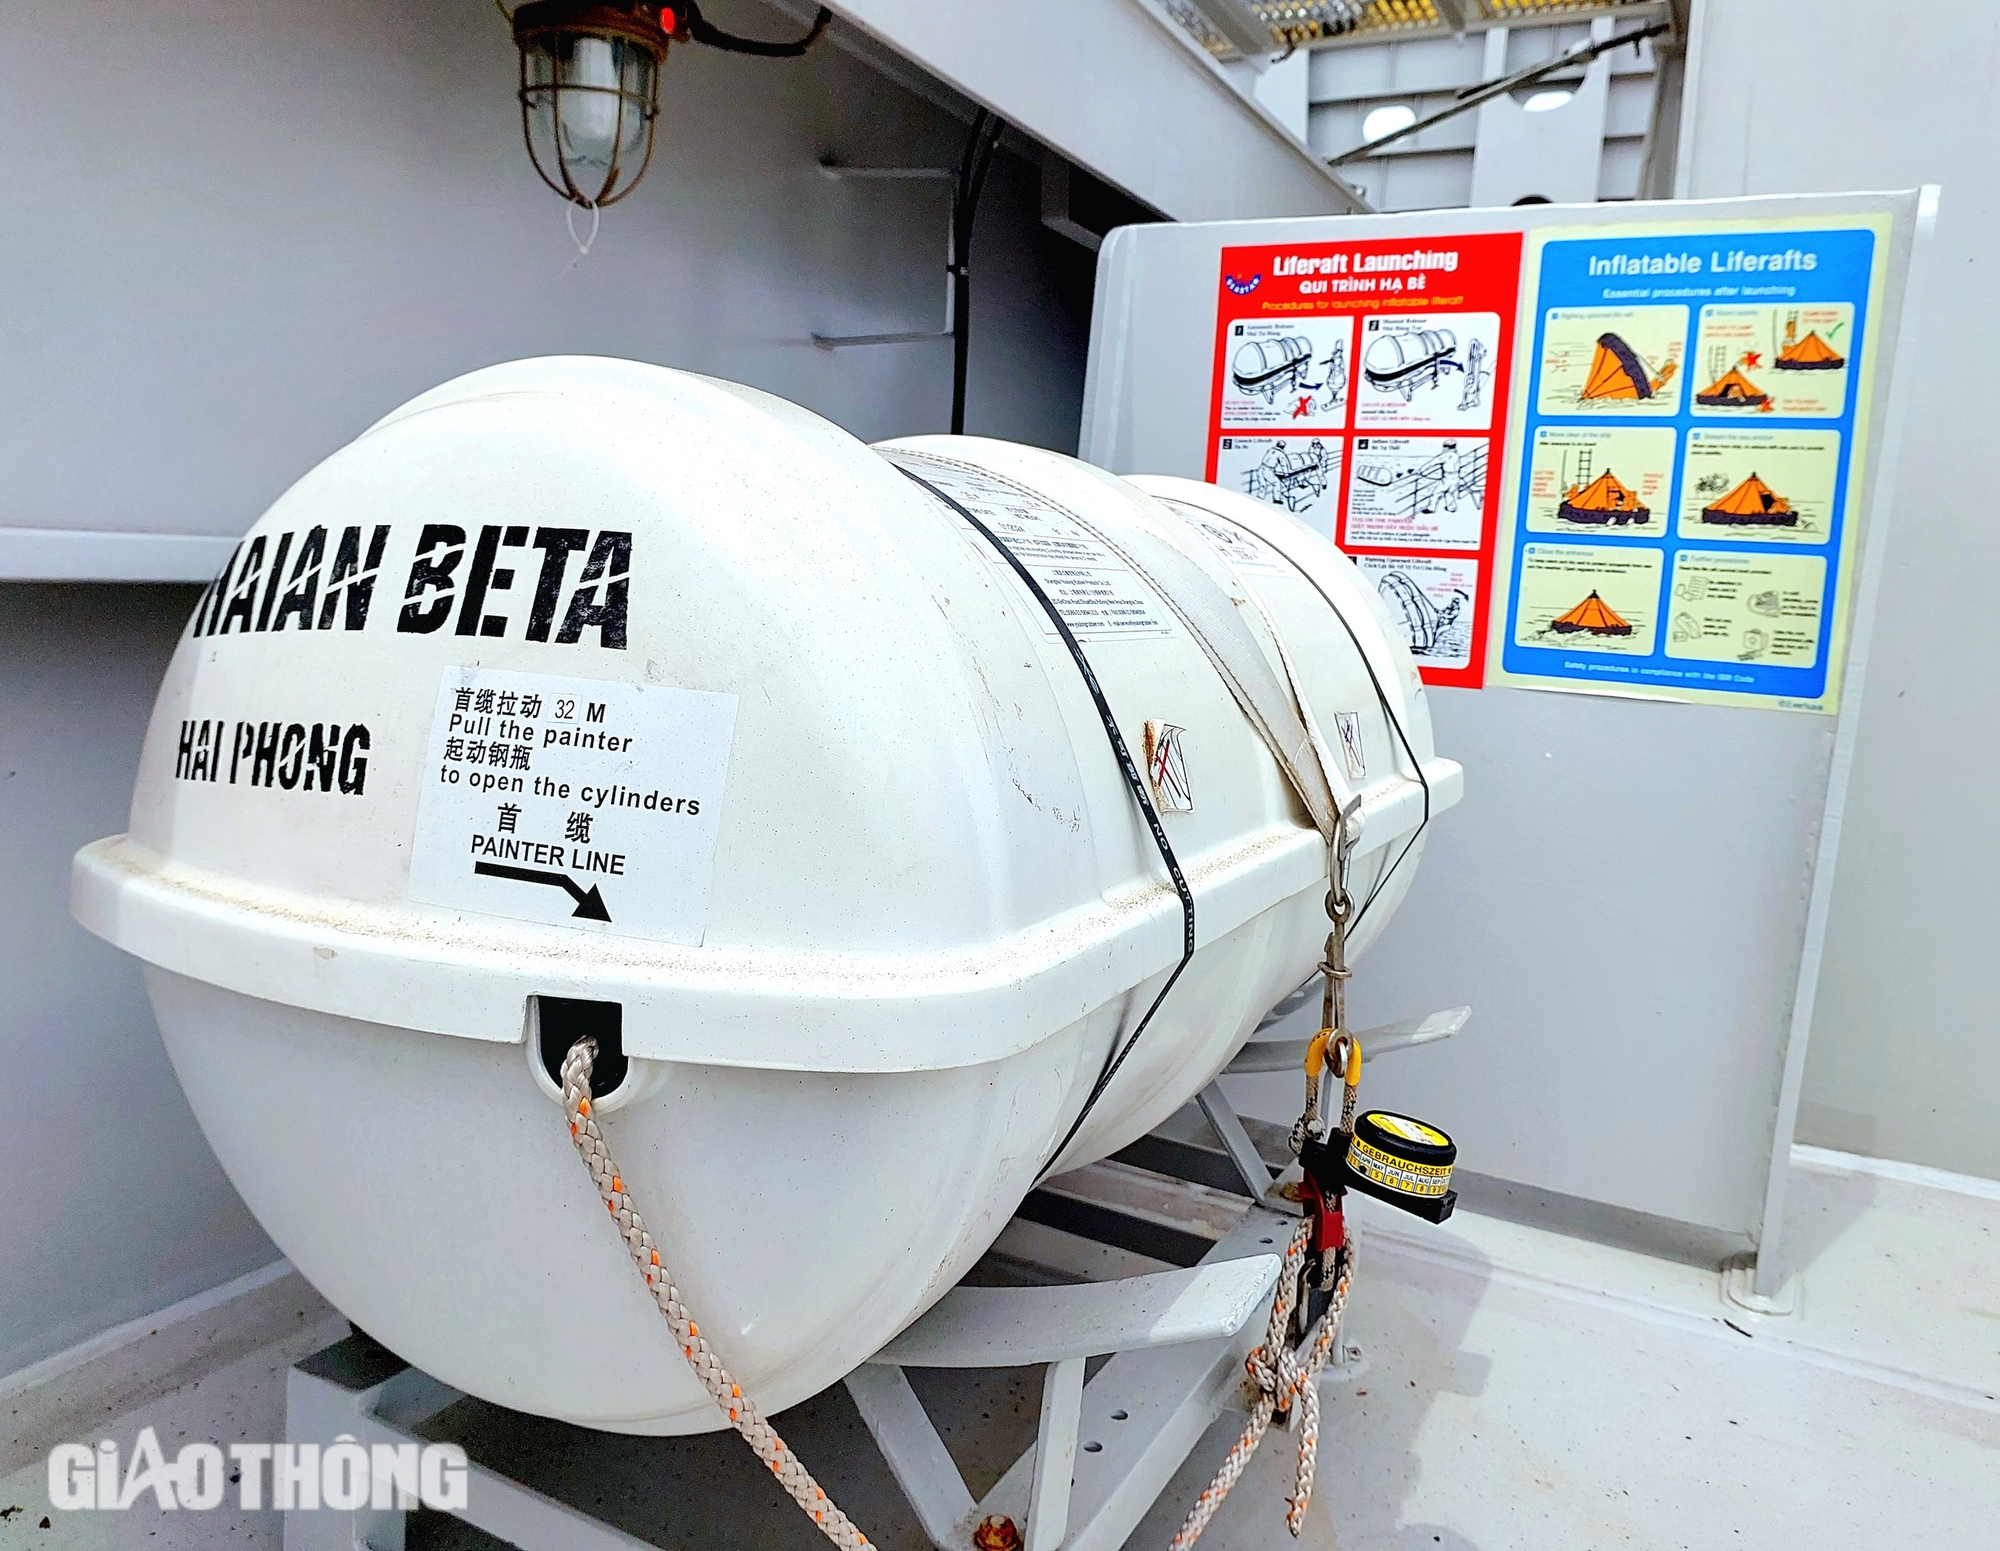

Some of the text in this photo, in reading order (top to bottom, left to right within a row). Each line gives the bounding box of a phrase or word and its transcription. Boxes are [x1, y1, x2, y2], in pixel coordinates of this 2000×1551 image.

[1272, 249, 1459, 276] Liferaft Launching
[1588, 248, 1818, 277] Inflatable Liferafts
[1299, 280, 1328, 294] QUI
[1331, 275, 1376, 293] TRÌNH
[1379, 277, 1403, 294] HẠ
[1602, 287, 1651, 299] Essential
[1713, 285, 1740, 297] after
[1741, 285, 1796, 298] launching
[396, 523, 633, 650] BETA
[454, 686, 607, 724] 首缆拉动 32 M
[448, 713, 633, 753] Pull the painter
[175, 719, 371, 796] HAI PHONG
[443, 736, 533, 771] 起动钢瓶
[440, 764, 701, 816] to open the cylinders
[470, 834, 627, 876] PAINTER LINE
[1153, 822, 1168, 851] NO
[1173, 866, 1194, 953] CUTTING
[1361, 1156, 1371, 1165] APR
[1373, 1163, 1385, 1172] MAY
[1387, 1169, 1400, 1178] JUN
[1402, 1174, 1414, 1182] JUL
[1362, 1144, 1447, 1176] GEBRAUCHSZEIT
